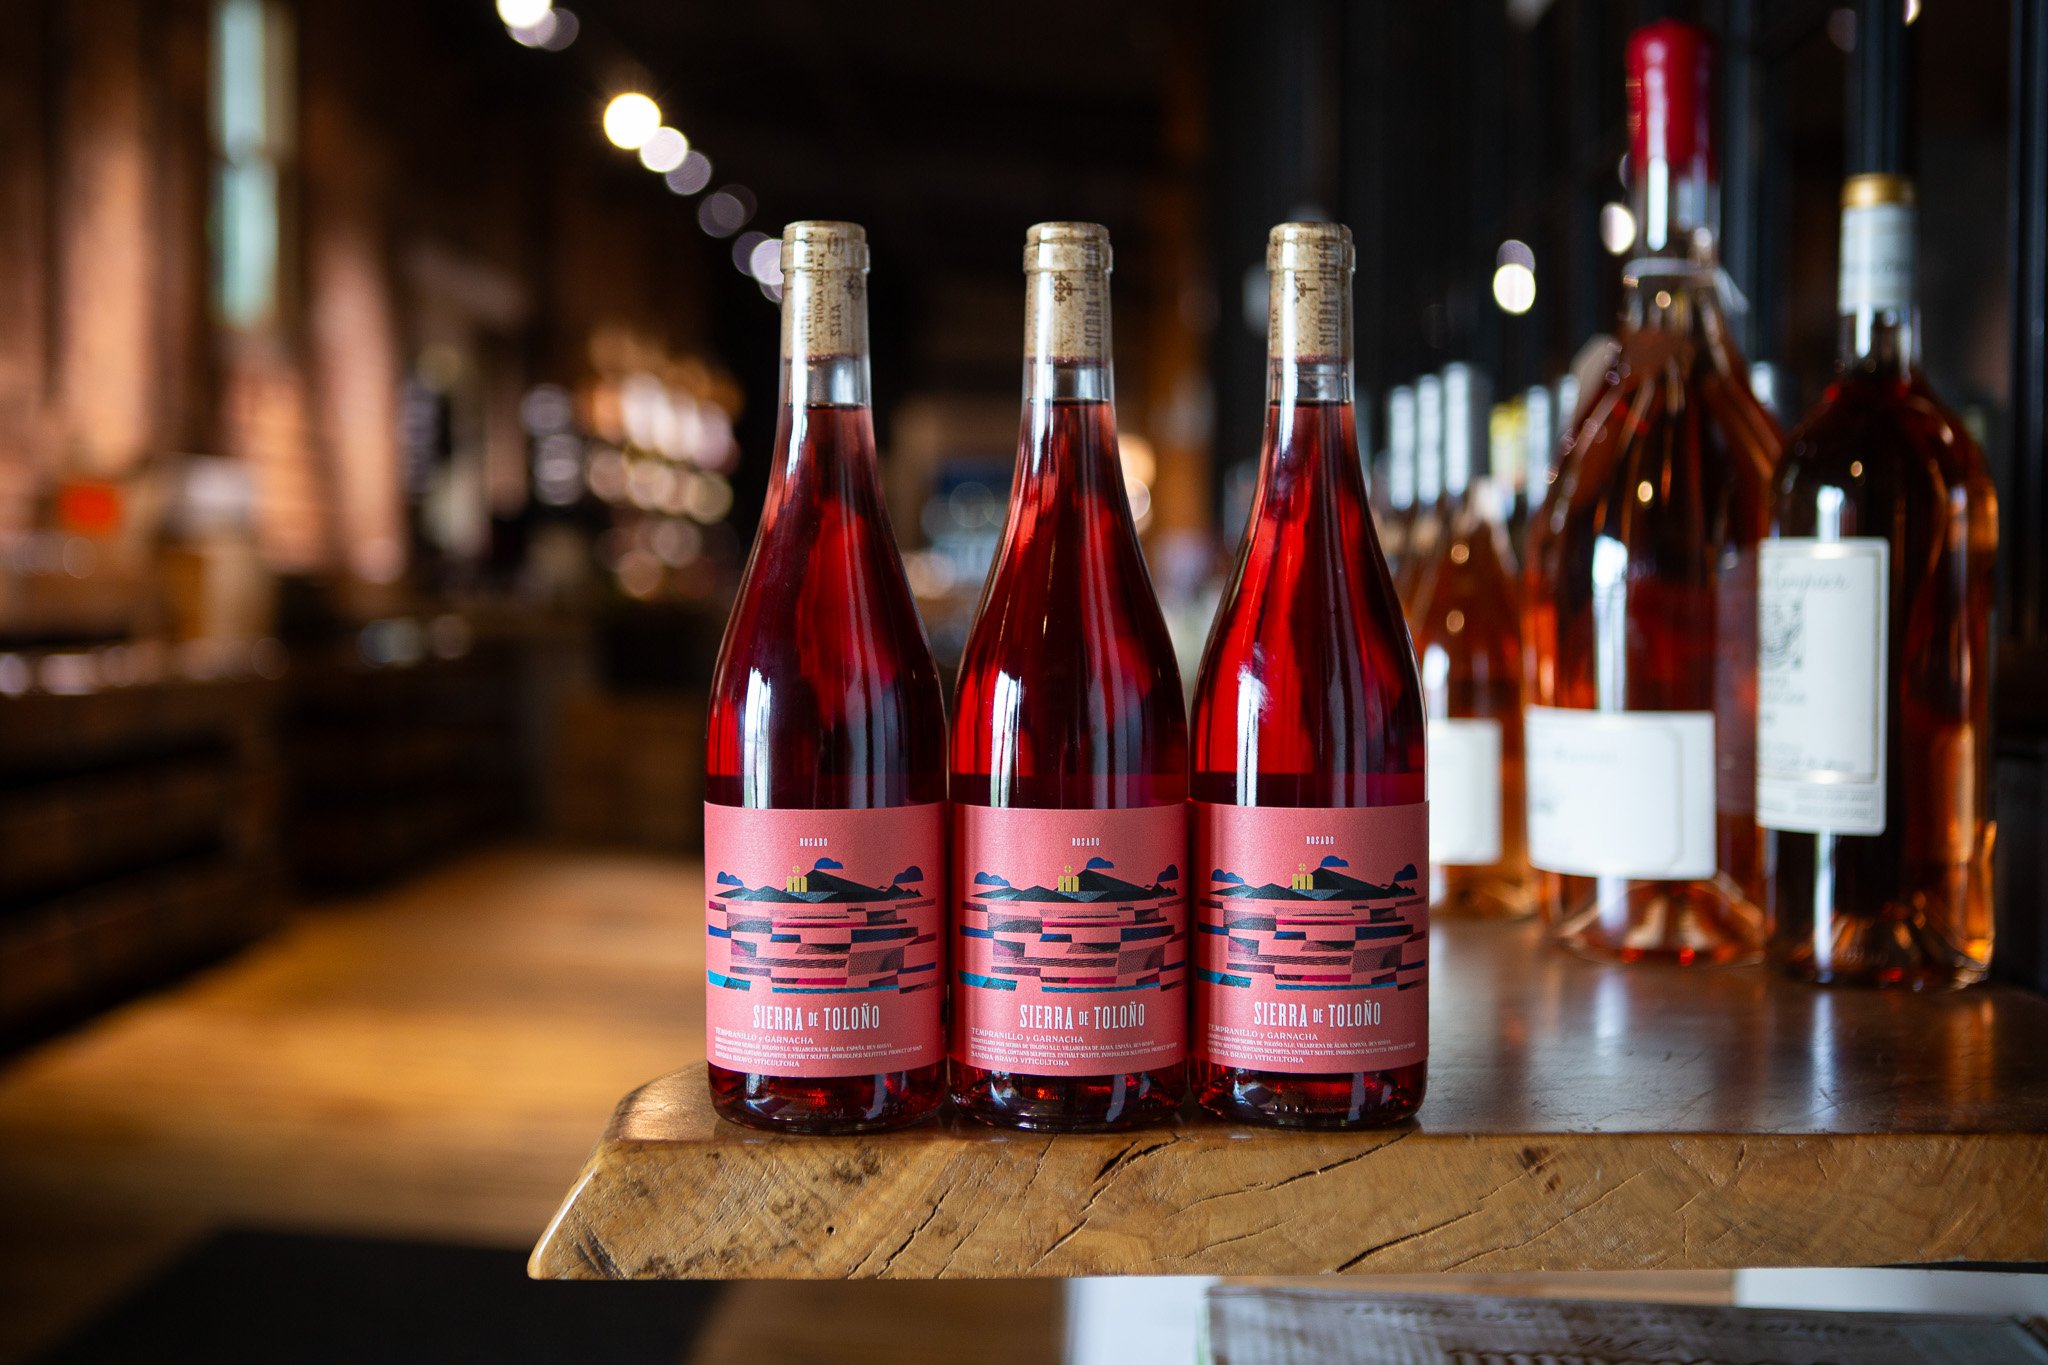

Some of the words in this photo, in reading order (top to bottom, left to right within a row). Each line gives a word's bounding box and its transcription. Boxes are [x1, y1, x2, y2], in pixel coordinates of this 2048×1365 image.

[1084, 300, 1102, 348] SIERRA
[1318, 300, 1338, 346] SIERRA
[753, 1004, 803, 1030] SIERRA
[808, 1012, 818, 1026] DE
[824, 1002, 880, 1030] TOLOÑO
[1020, 1004, 1073, 1030] SIERRA
[1078, 1011, 1089, 1026] DE
[1094, 1001, 1144, 1029] TOLOÑO
[1254, 1002, 1308, 1027] SIERRA
[1313, 1009, 1323, 1023] DE
[1328, 999, 1380, 1027] TOLOÑO
[765, 1035, 814, 1044] GARNACHA
[971, 1027, 1023, 1040] TEMPRANILLO
[1033, 1035, 1084, 1044] GARNACHA
[1208, 1023, 1258, 1038] TEMPRANILLO
[1267, 1032, 1318, 1040] GARNACHA
[995, 1055, 1018, 1064] BRAVO
[1020, 1058, 1069, 1066] VITICULTORA
[1254, 1054, 1304, 1063] VITICULTORA
